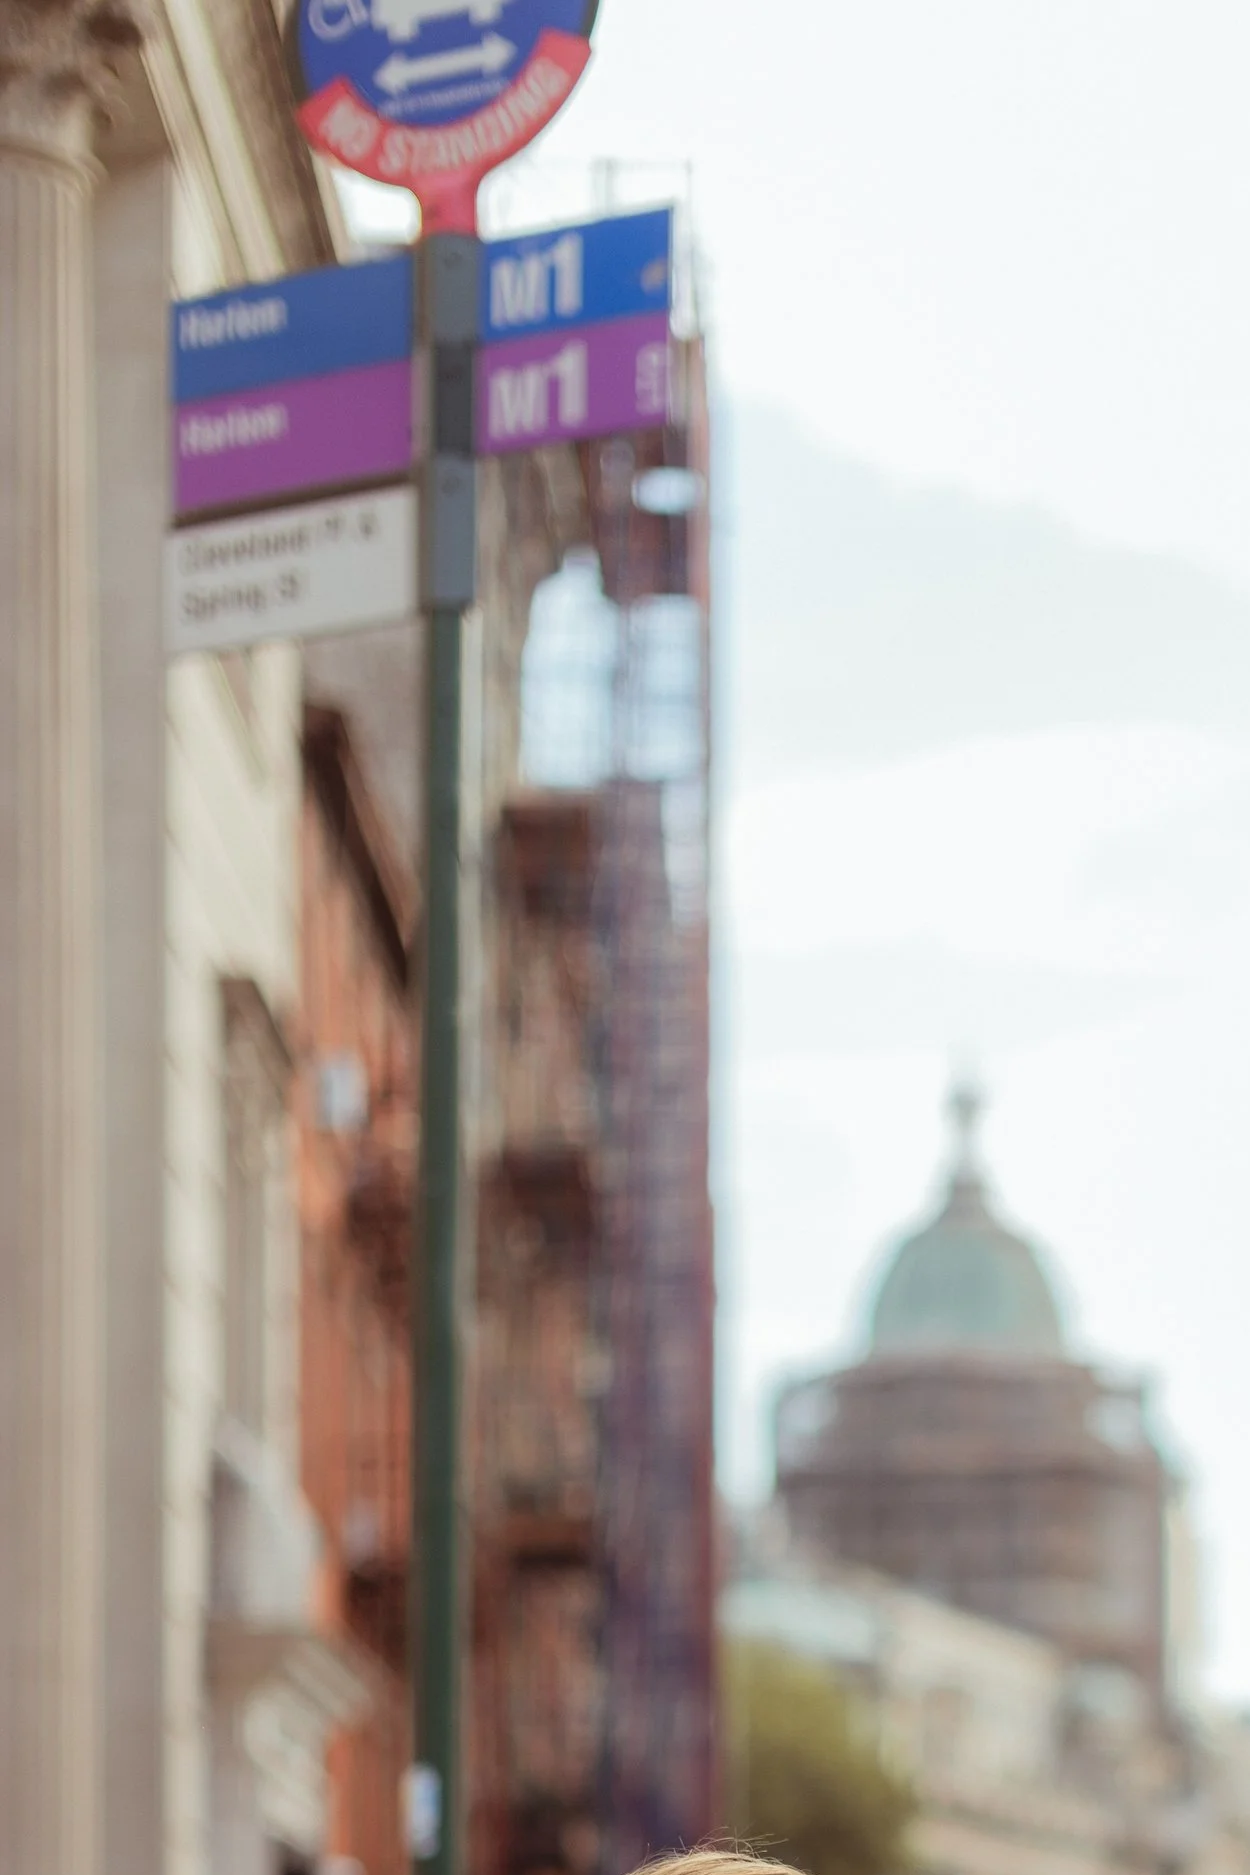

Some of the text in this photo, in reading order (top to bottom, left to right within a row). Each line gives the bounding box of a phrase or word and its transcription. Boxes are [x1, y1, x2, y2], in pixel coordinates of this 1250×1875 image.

[319, 97, 380, 161] NO
[378, 57, 570, 175] STANDING
[490, 231, 584, 329] M1
[489, 338, 589, 440] M1
